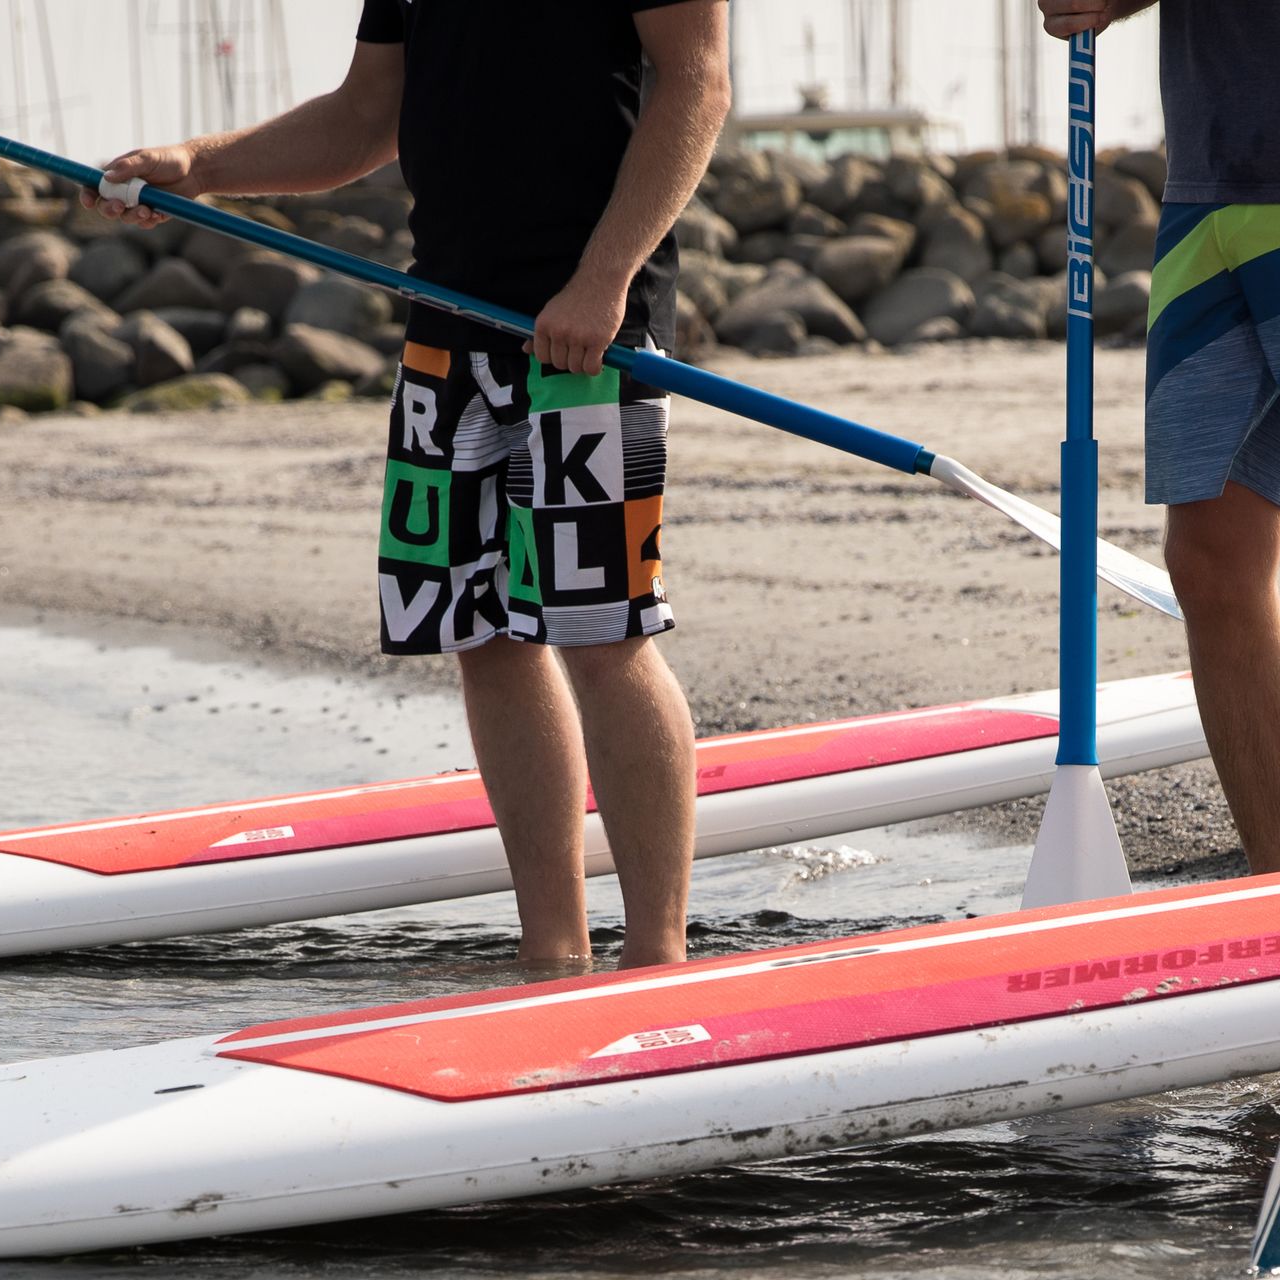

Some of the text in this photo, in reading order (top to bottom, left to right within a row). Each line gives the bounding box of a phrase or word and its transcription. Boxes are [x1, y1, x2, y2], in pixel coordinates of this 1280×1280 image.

[402, 380, 445, 456] R
[540, 411, 612, 505] K
[388, 478, 440, 546] U
[553, 521, 606, 591] L
[379, 572, 442, 642] V
